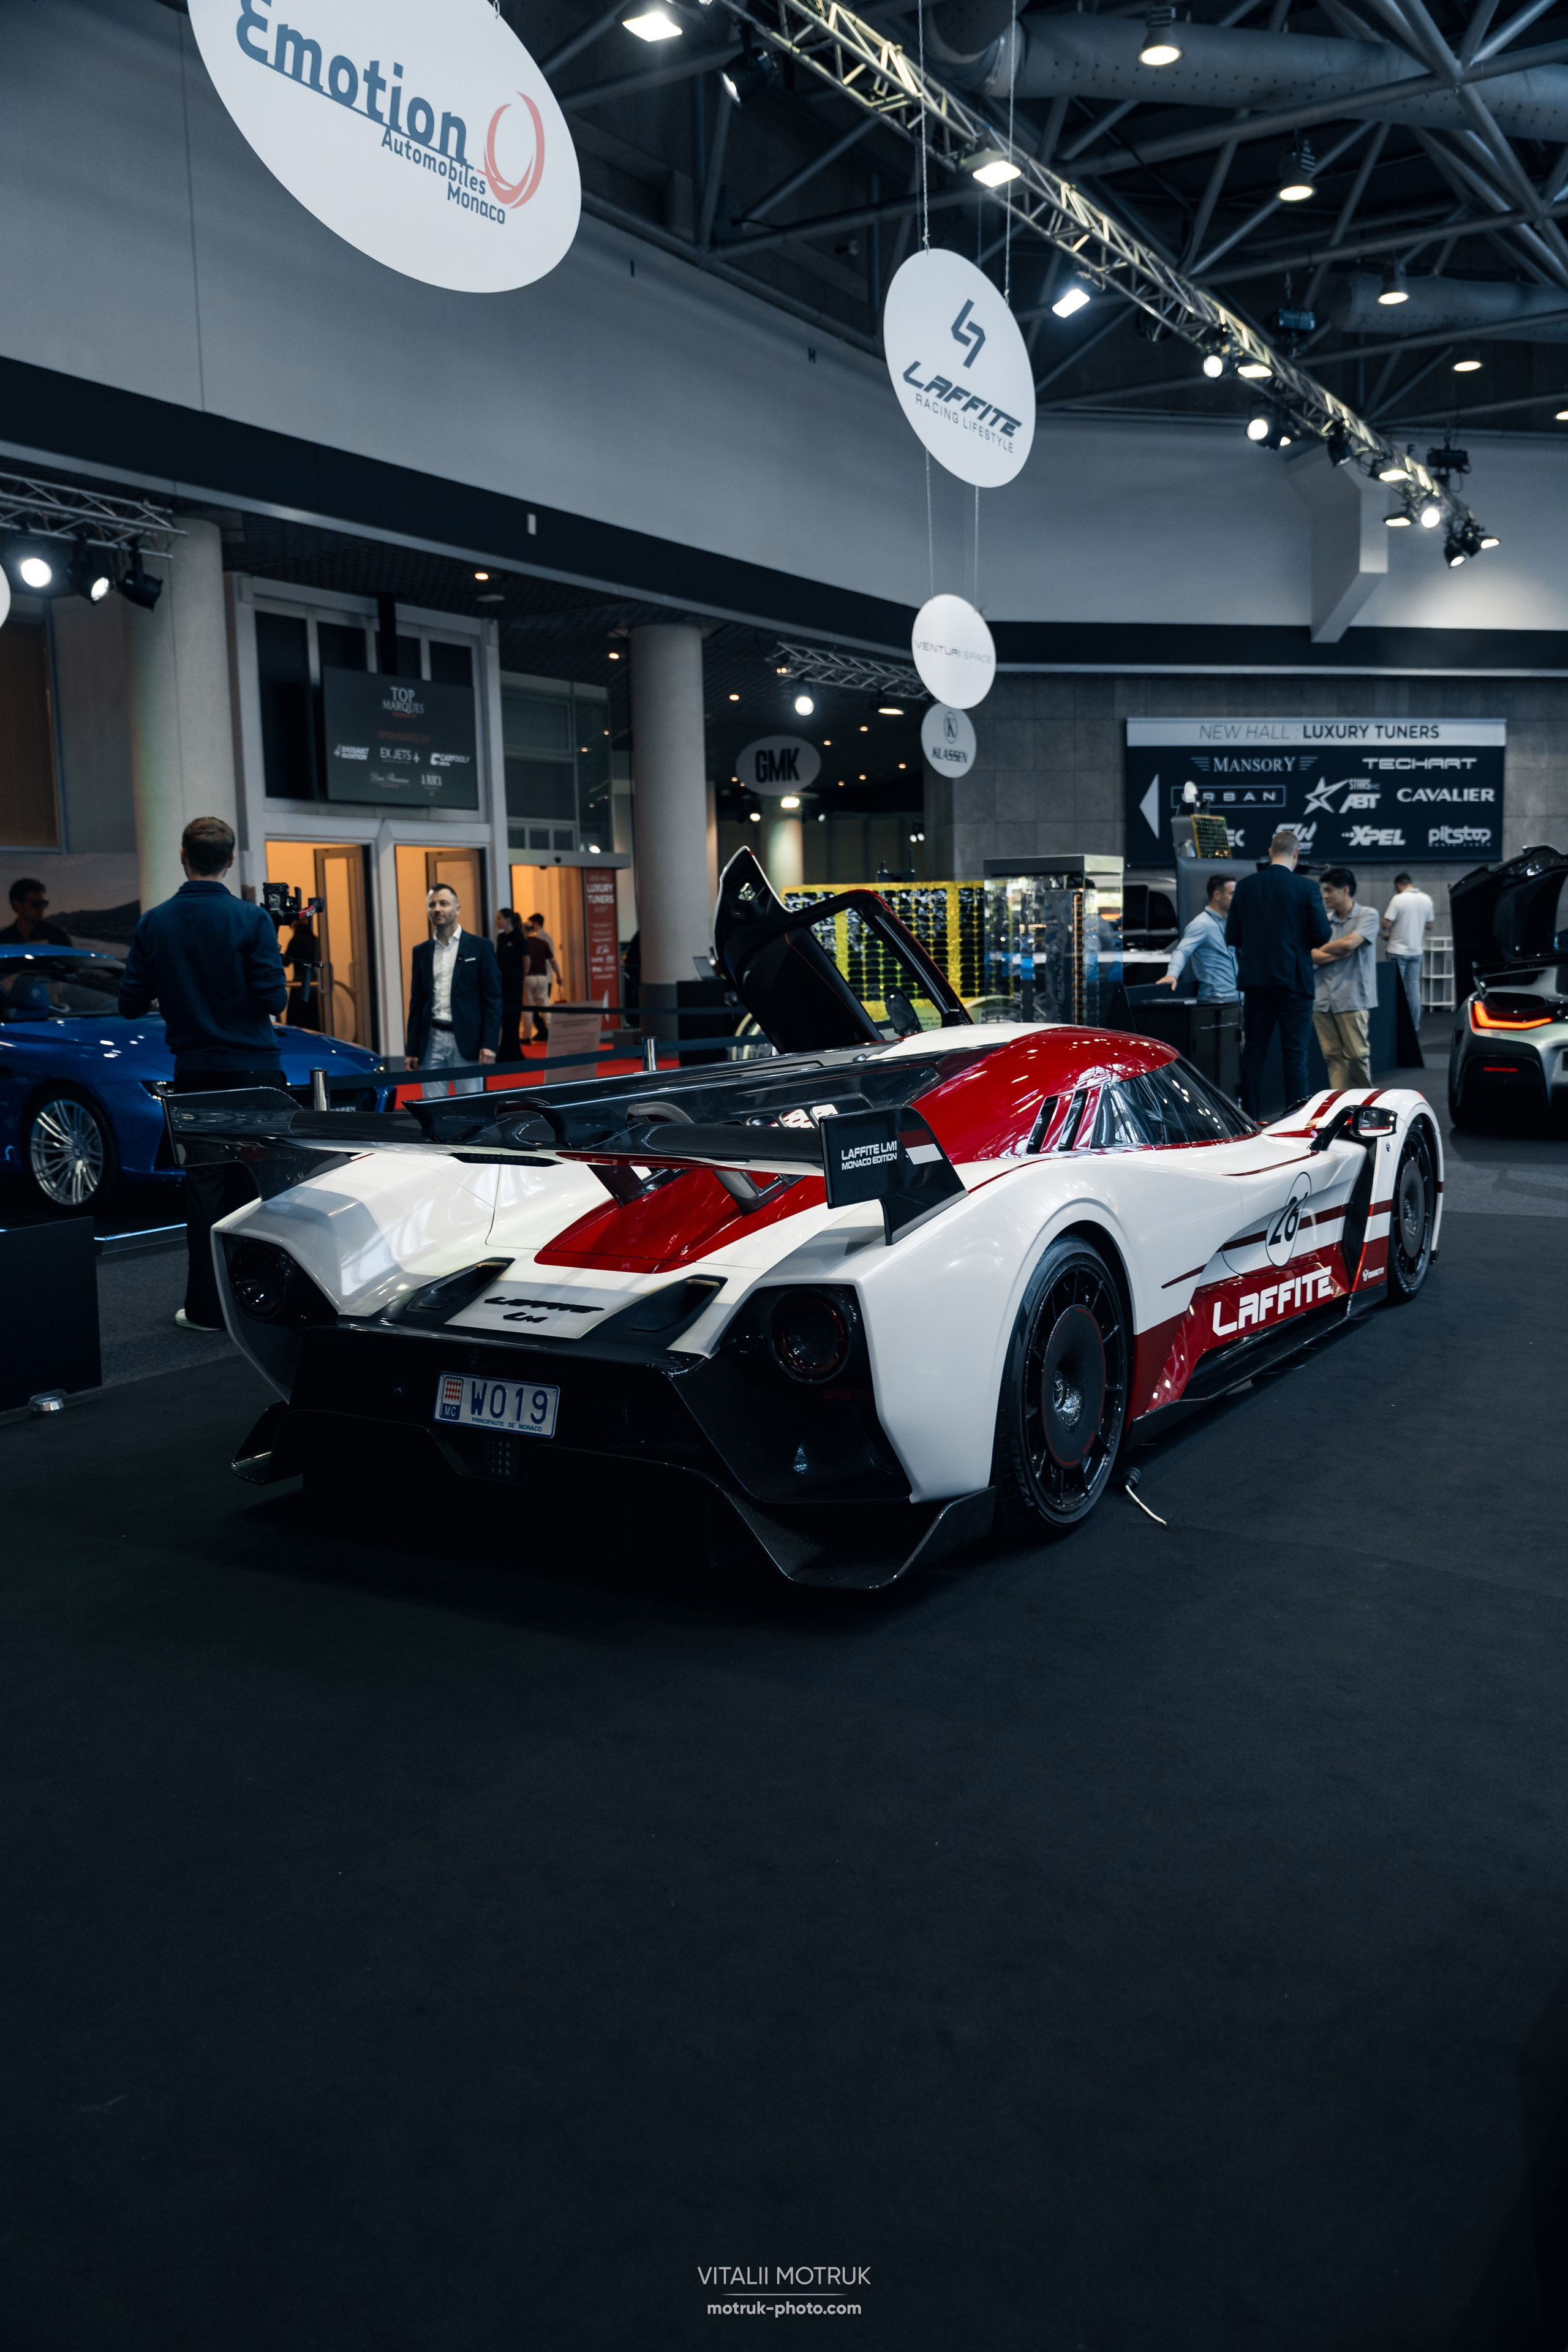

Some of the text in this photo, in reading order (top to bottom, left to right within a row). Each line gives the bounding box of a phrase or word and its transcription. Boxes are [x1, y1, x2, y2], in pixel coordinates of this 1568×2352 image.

[236, 0, 470, 166] Emotion
[381, 129, 486, 195] Automobiles
[447, 182, 505, 224] Monaco
[903, 361, 1022, 437] LAFFITE
[916, 393, 1014, 453] RACING LIFESTYLE
[914, 640, 993, 665] VENTURI SPACE
[390, 686, 415, 703] TOP
[1199, 725, 1241, 739] NEW
[1246, 725, 1289, 739] HALL
[1303, 725, 1369, 739] LUXURY
[1374, 725, 1439, 739] TUNERS
[380, 747, 412, 760] EX JETS
[932, 747, 968, 764] KLASSEN
[755, 748, 800, 783] GMK
[1213, 757, 1296, 772] MANSORY
[1362, 757, 1477, 769] TECHART
[1339, 793, 1381, 813] ABT
[1396, 788, 1495, 802] CAVALIER
[1428, 825, 1491, 845] pitstop
[587, 883, 614, 892] LUXURY
[587, 894, 614, 904] TUNERS
[842, 1144, 880, 1160] LAFFITE
[842, 1153, 897, 1170] MONACO EDITION
[1213, 1266, 1332, 1336] LAFFITE
[444, 1405, 456, 1417] MC
[472, 1417, 504, 1427] PRINCIPAUTE
